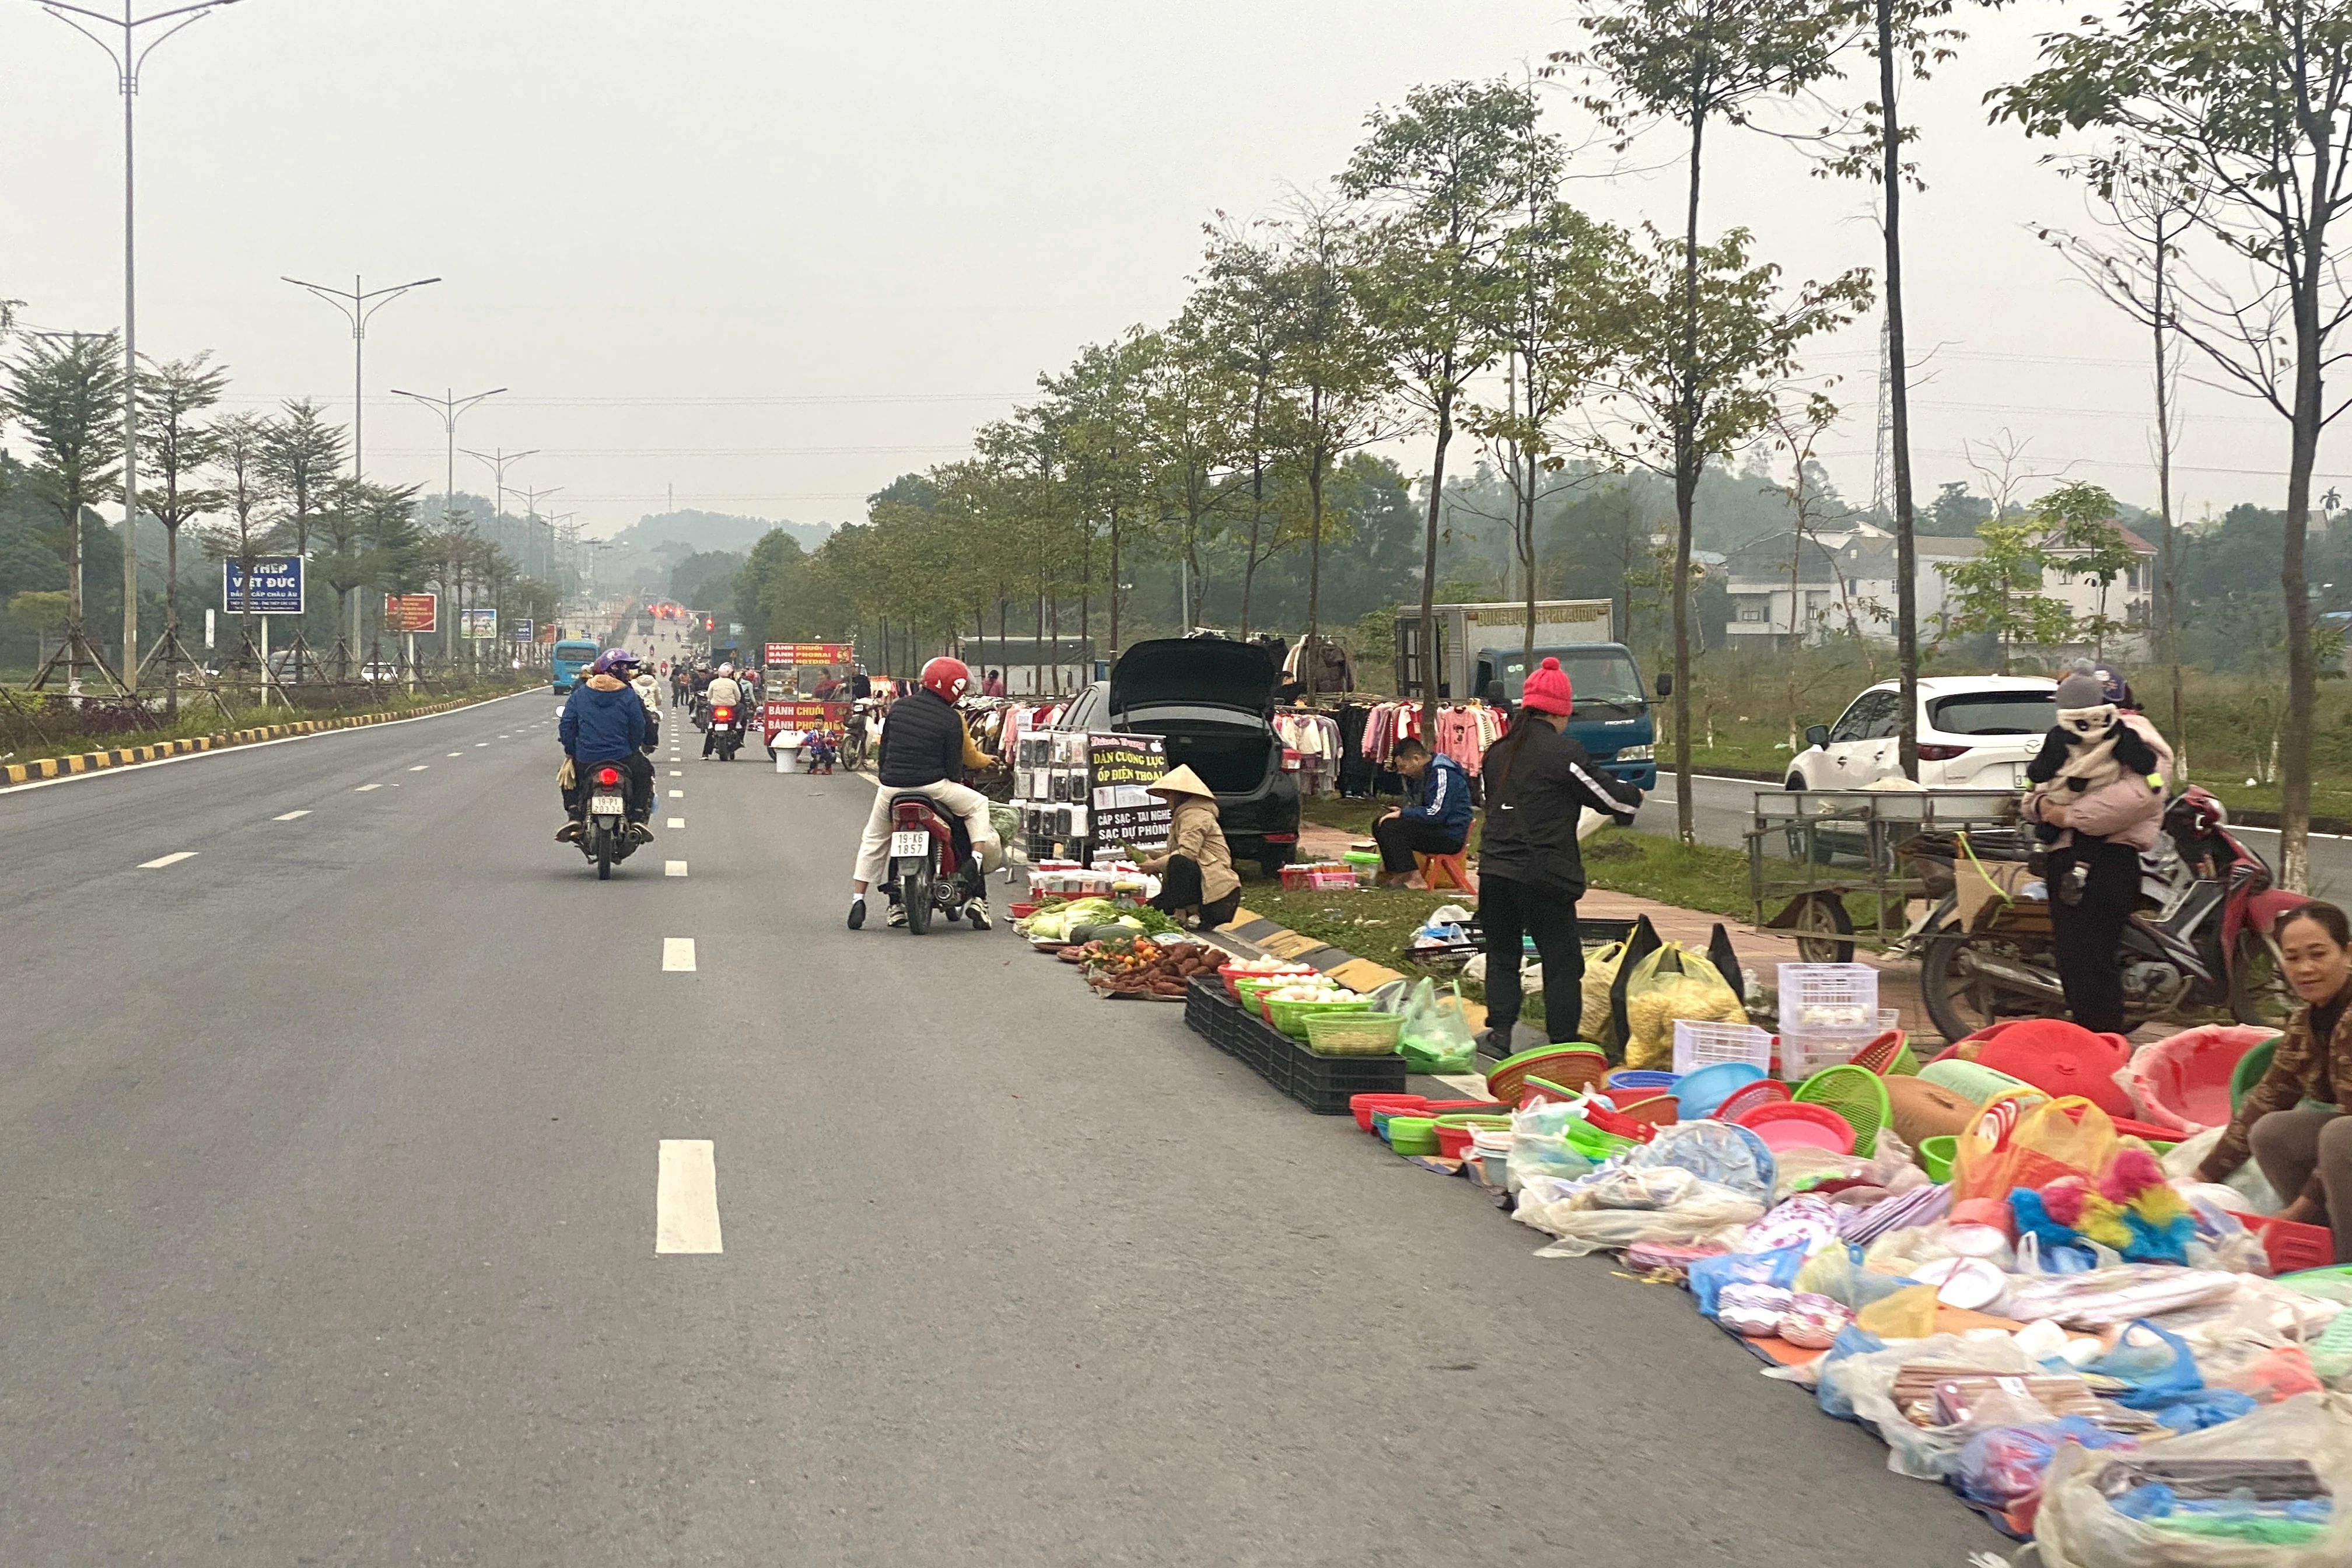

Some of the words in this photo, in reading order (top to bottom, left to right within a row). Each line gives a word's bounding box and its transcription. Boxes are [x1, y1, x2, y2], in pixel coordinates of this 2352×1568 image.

[232, 575, 262, 590] VỆT
[266, 575, 295, 587] ĐỨC
[768, 705, 794, 715] BÁNH
[768, 719, 794, 729] BÁNH
[796, 721, 832, 729] PHOAI
[1115, 750, 1144, 765] CƯỜNG
[1146, 755, 1164, 768] LỰC
[1097, 765, 1110, 781] ỐP
[1111, 765, 1133, 782] ĐIỆN
[1098, 813, 1113, 825] CÁP
[1115, 813, 1130, 825] SẠC
[1137, 811, 1150, 822] TAI
[1150, 809, 1172, 821] NGHE
[899, 834, 923, 844] 19-K6
[1098, 828, 1119, 841] SẠC
[1121, 826, 1136, 839] DỰ
[898, 844, 922, 854] 1857
